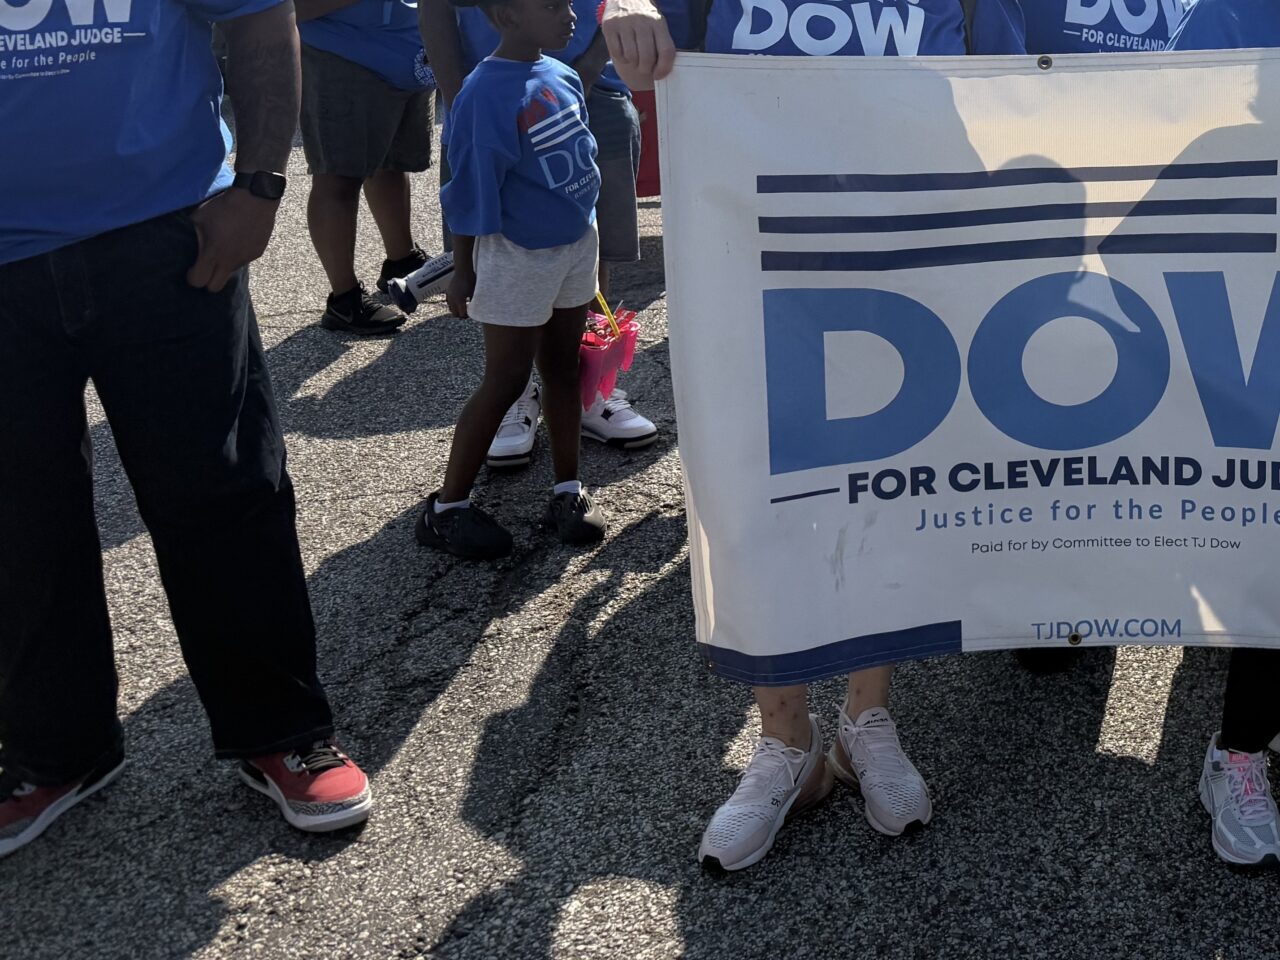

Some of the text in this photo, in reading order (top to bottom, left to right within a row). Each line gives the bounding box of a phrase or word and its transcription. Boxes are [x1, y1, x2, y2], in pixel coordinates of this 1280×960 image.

[0, 27, 122, 52] EVELAND JUDGE
[1081, 28, 1167, 52] FOR CLEVELAND
[11, 56, 30, 68] for
[34, 54, 54, 66] the
[58, 50, 97, 65] People
[538, 134, 596, 190] DO
[848, 465, 938, 504] FOR
[948, 455, 1202, 492] CLEVELAND
[915, 503, 1033, 531] Justice
[1050, 499, 1096, 521] for
[1113, 497, 1163, 520] the
[971, 535, 1241, 554] Paid for by Committee to Elect TJ Dow
[1031, 618, 1182, 640] TJDOW.COM
